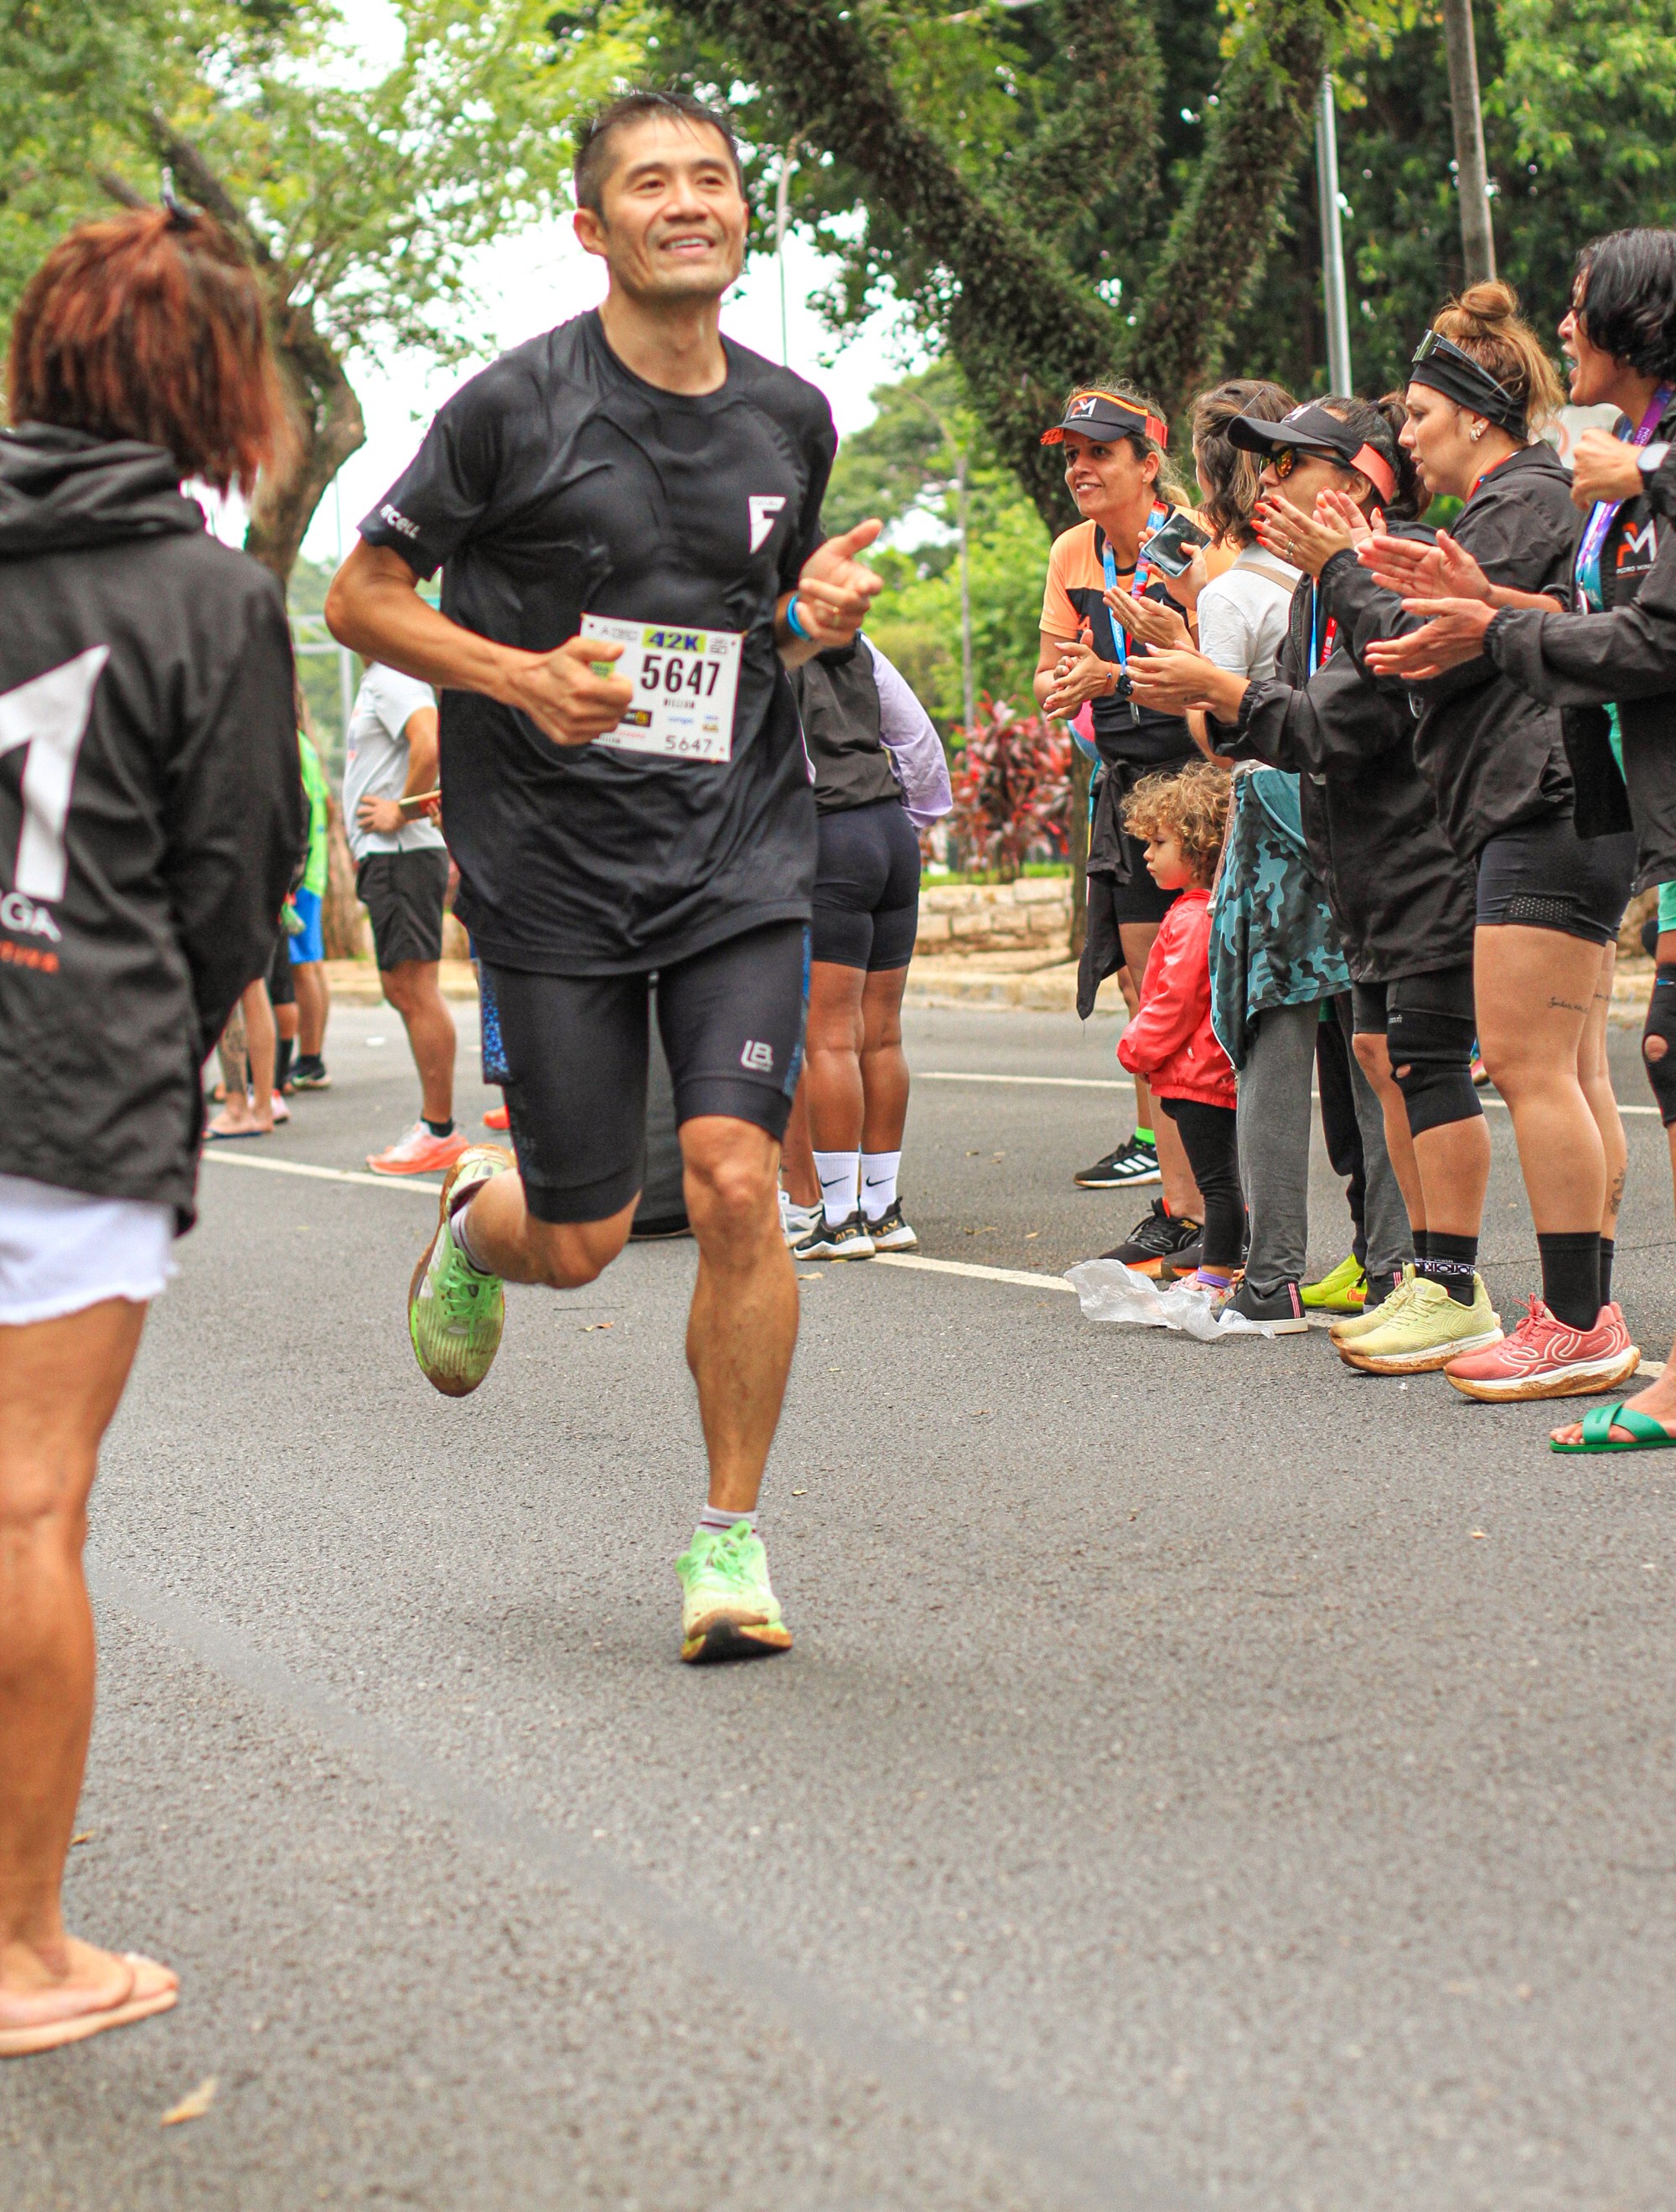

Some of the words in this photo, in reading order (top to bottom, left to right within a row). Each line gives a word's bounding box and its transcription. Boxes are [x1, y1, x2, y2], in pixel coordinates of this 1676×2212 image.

[649, 631, 699, 652] 42K
[640, 654, 720, 696] 5647
[665, 734, 713, 753] 5647
